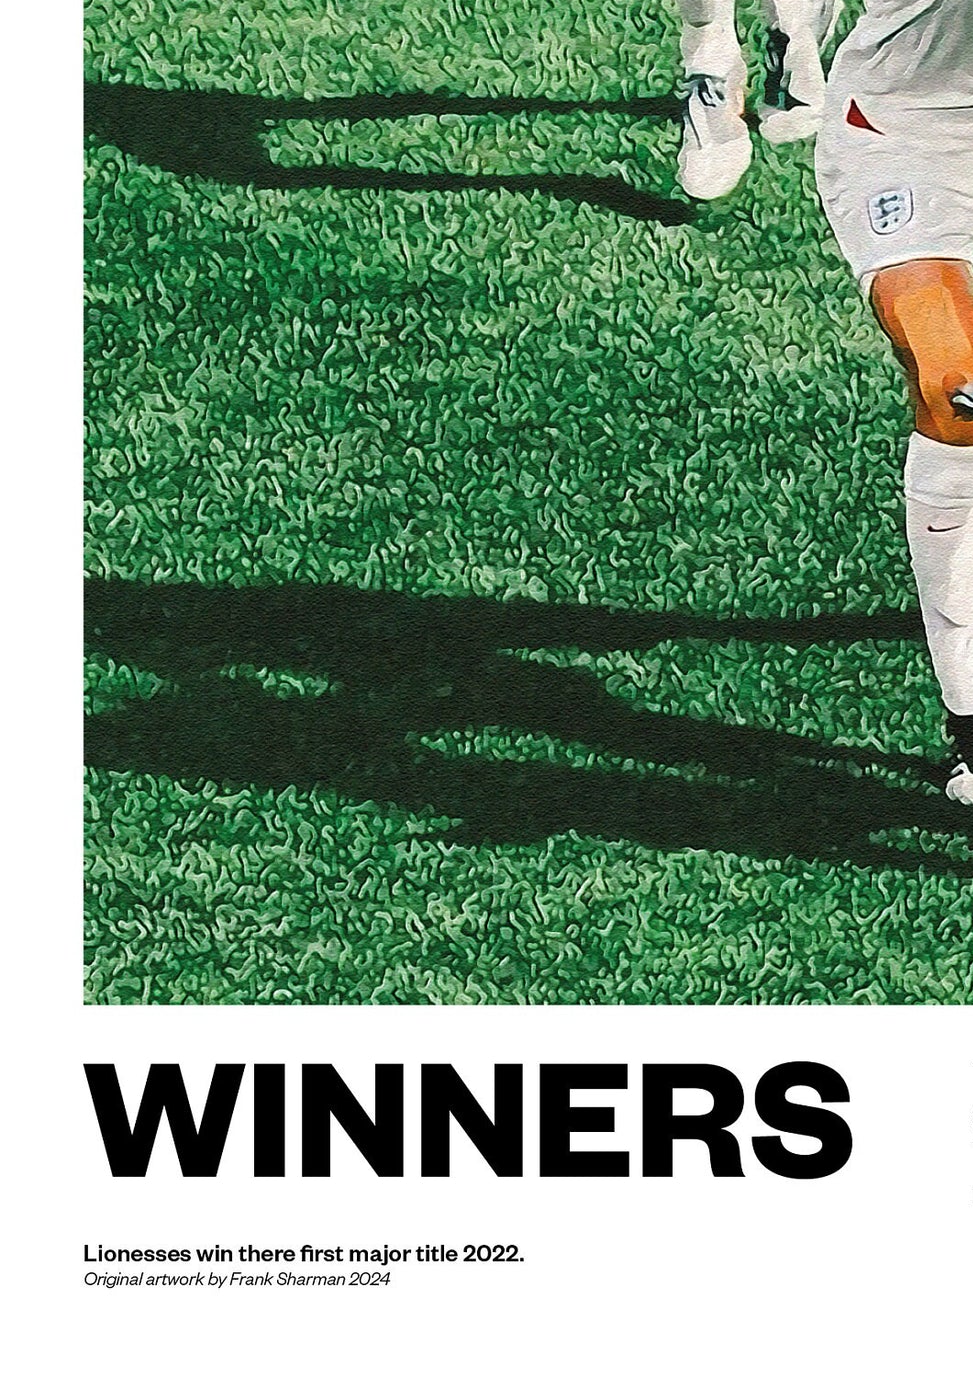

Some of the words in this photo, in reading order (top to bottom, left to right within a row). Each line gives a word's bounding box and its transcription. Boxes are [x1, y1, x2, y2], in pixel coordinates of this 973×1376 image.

[83, 1061, 852, 1179] WINNERS
[84, 1245, 191, 1262] Lionesses
[196, 1245, 232, 1262] win
[238, 1245, 295, 1262] there
[300, 1245, 343, 1262] first
[350, 1245, 411, 1266] major
[416, 1245, 458, 1262] title
[463, 1245, 524, 1262] 2022.
[84, 1272, 143, 1288] Original
[146, 1272, 205, 1285] artwork
[208, 1272, 227, 1288] by
[230, 1272, 274, 1285] Frank
[277, 1272, 345, 1285] Sharman
[348, 1272, 390, 1285] 2024
